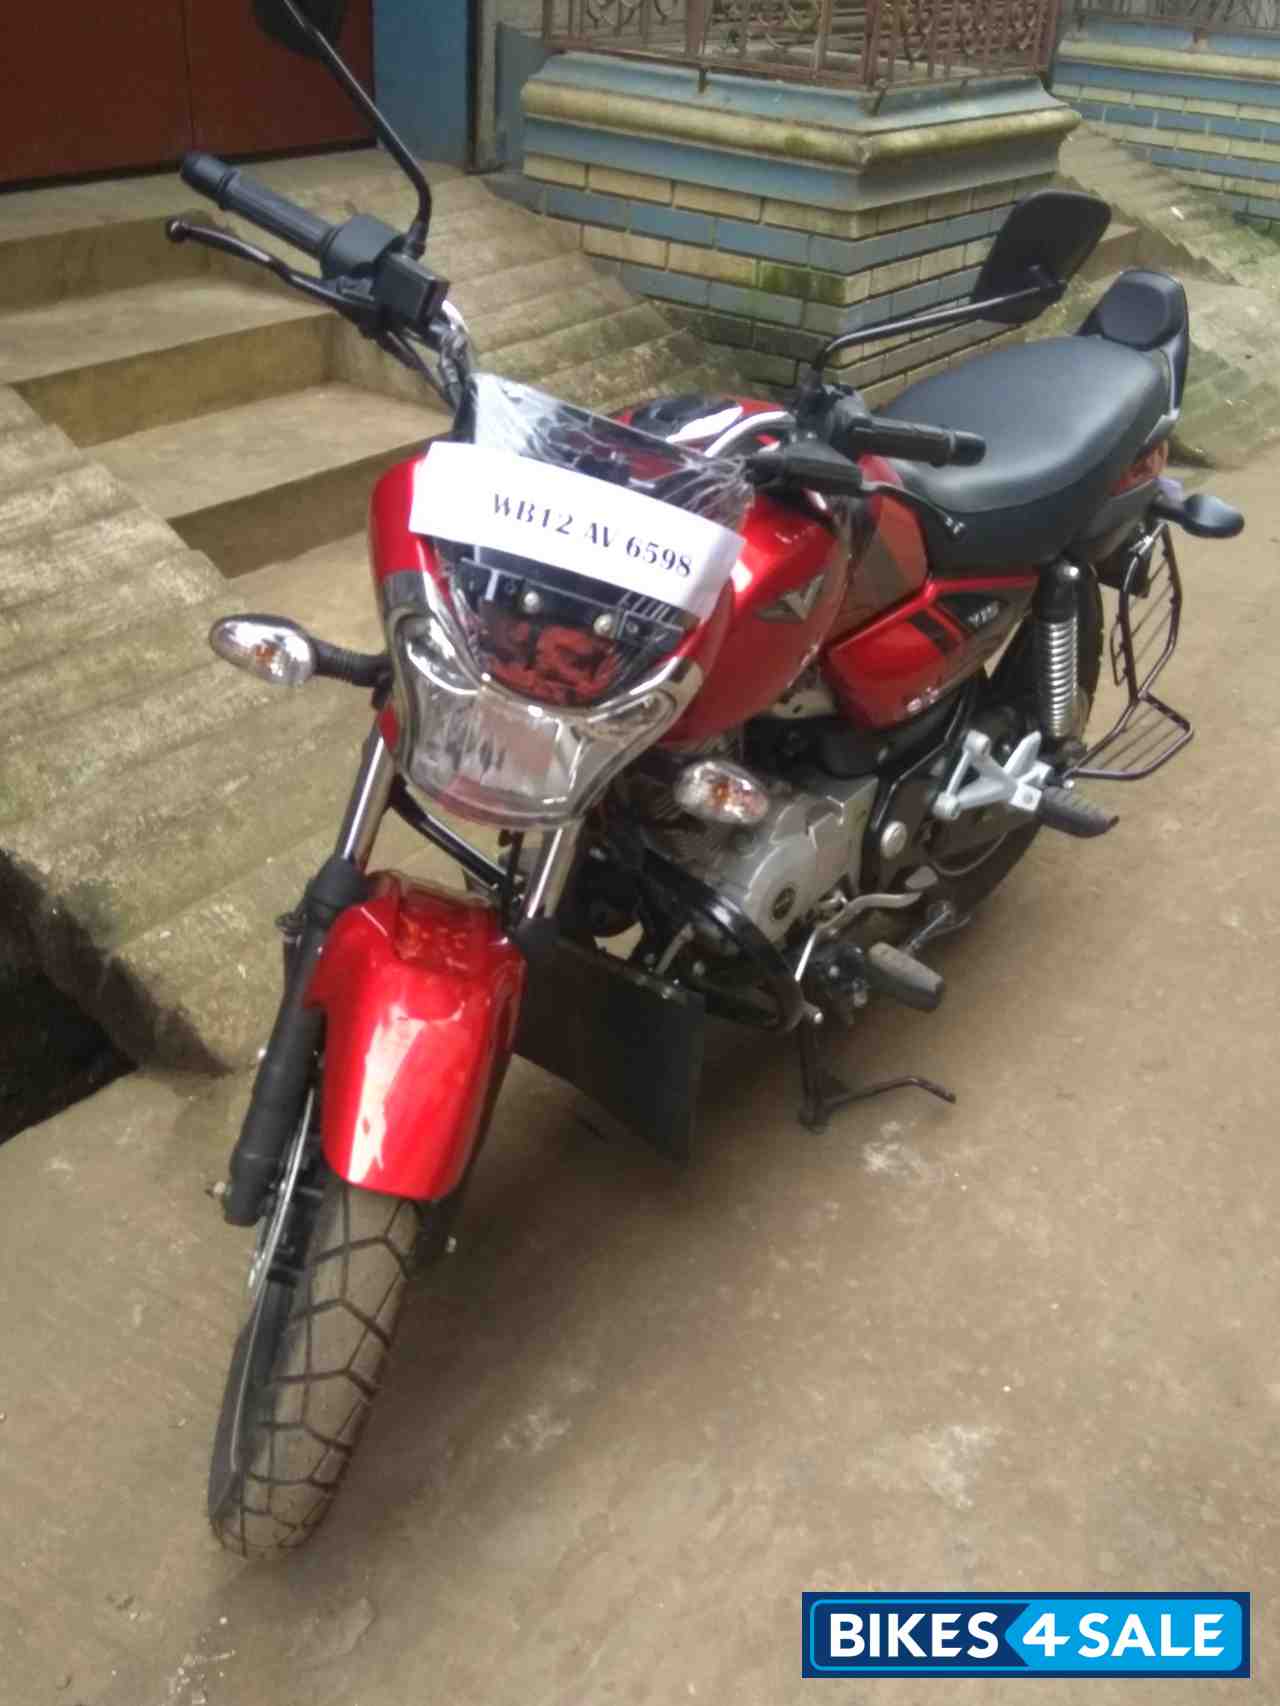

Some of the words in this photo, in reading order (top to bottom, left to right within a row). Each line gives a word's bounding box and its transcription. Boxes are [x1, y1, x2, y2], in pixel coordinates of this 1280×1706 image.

[492, 493, 574, 536] WB12
[584, 522, 615, 549] AV
[625, 535, 693, 578] 6598
